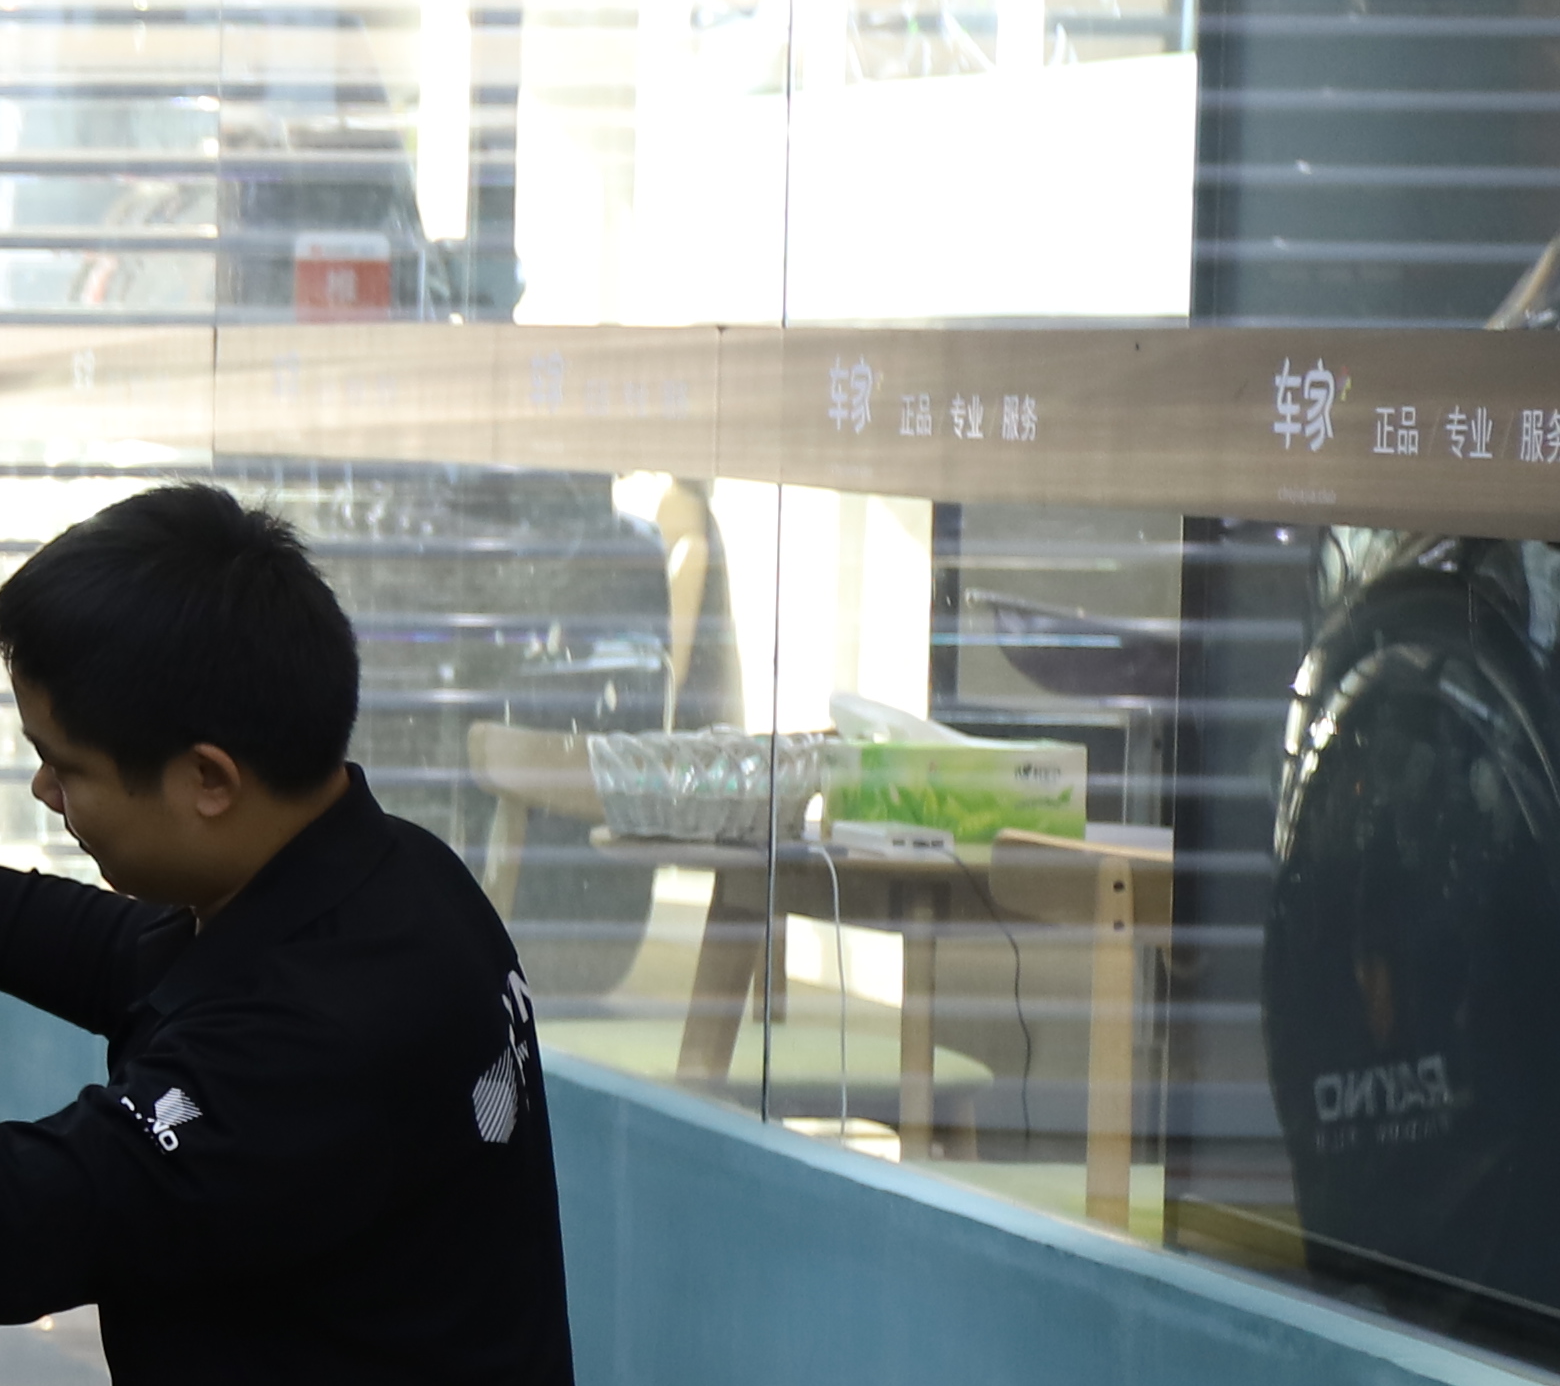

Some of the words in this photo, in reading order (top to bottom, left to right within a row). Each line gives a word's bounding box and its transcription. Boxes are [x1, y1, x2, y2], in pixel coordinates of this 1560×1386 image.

[829, 355, 873, 435] 车家
[899, 392, 933, 437] 正品
[949, 392, 984, 440] 专业
[1002, 393, 1039, 442] 服务
[1273, 356, 1335, 452] 车家
[1373, 406, 1419, 455] 正品
[1445, 404, 1494, 459] 专业
